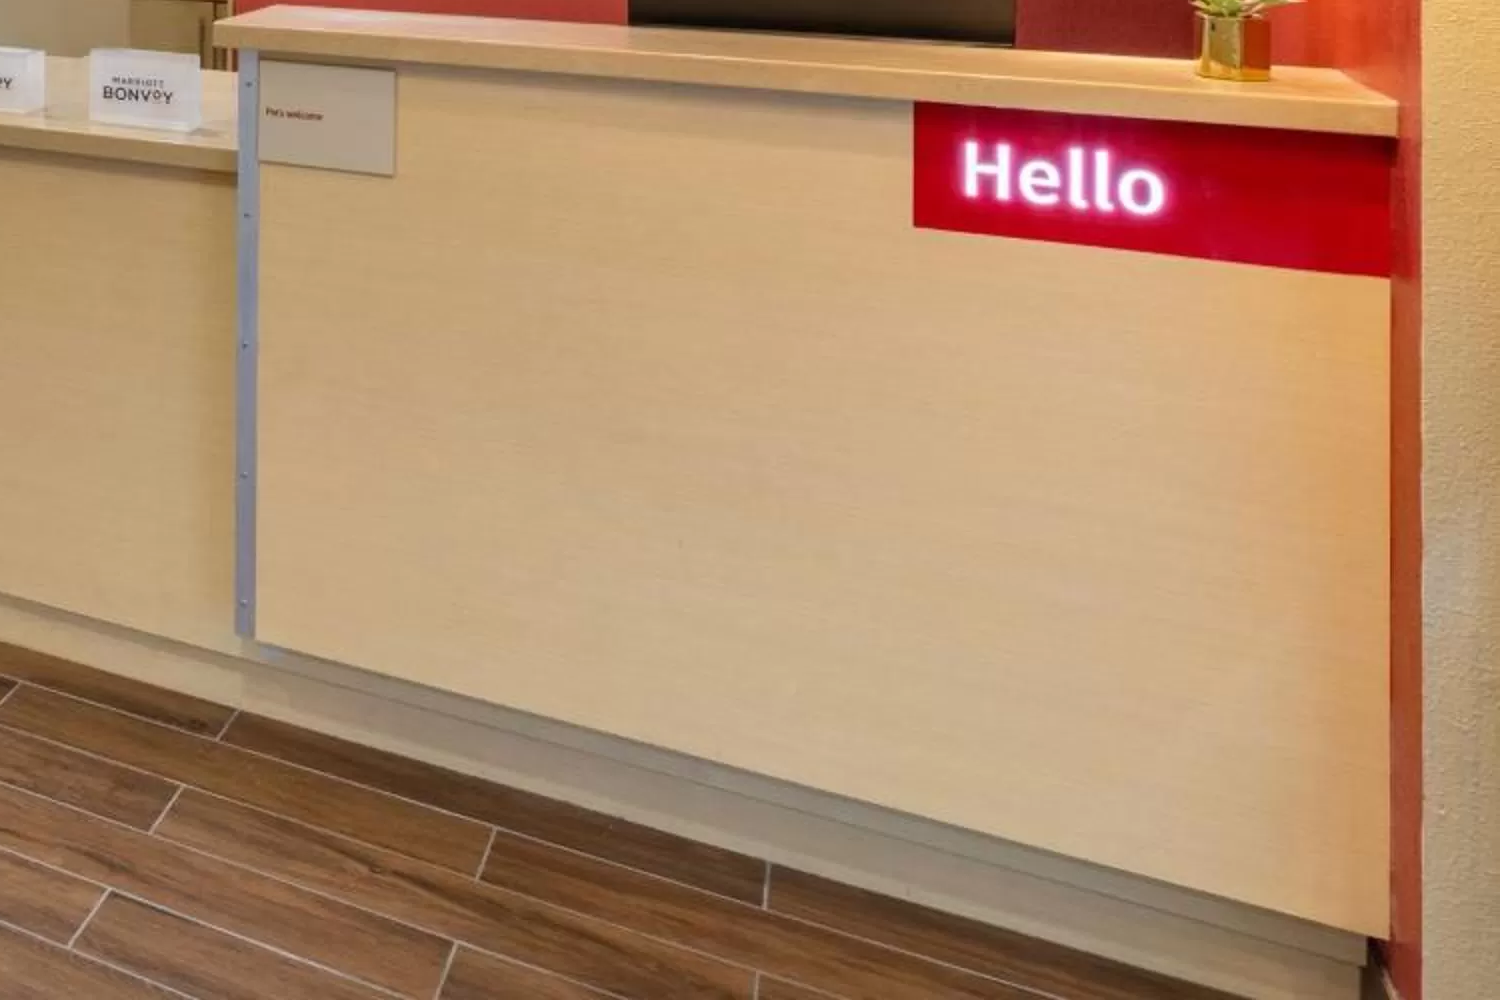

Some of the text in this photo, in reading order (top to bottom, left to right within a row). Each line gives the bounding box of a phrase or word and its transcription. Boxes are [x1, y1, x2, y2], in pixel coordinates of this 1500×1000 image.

[111, 75, 165, 88] MARRIOTT
[102, 85, 175, 106] BONVOY
[963, 140, 1167, 217] Hello
